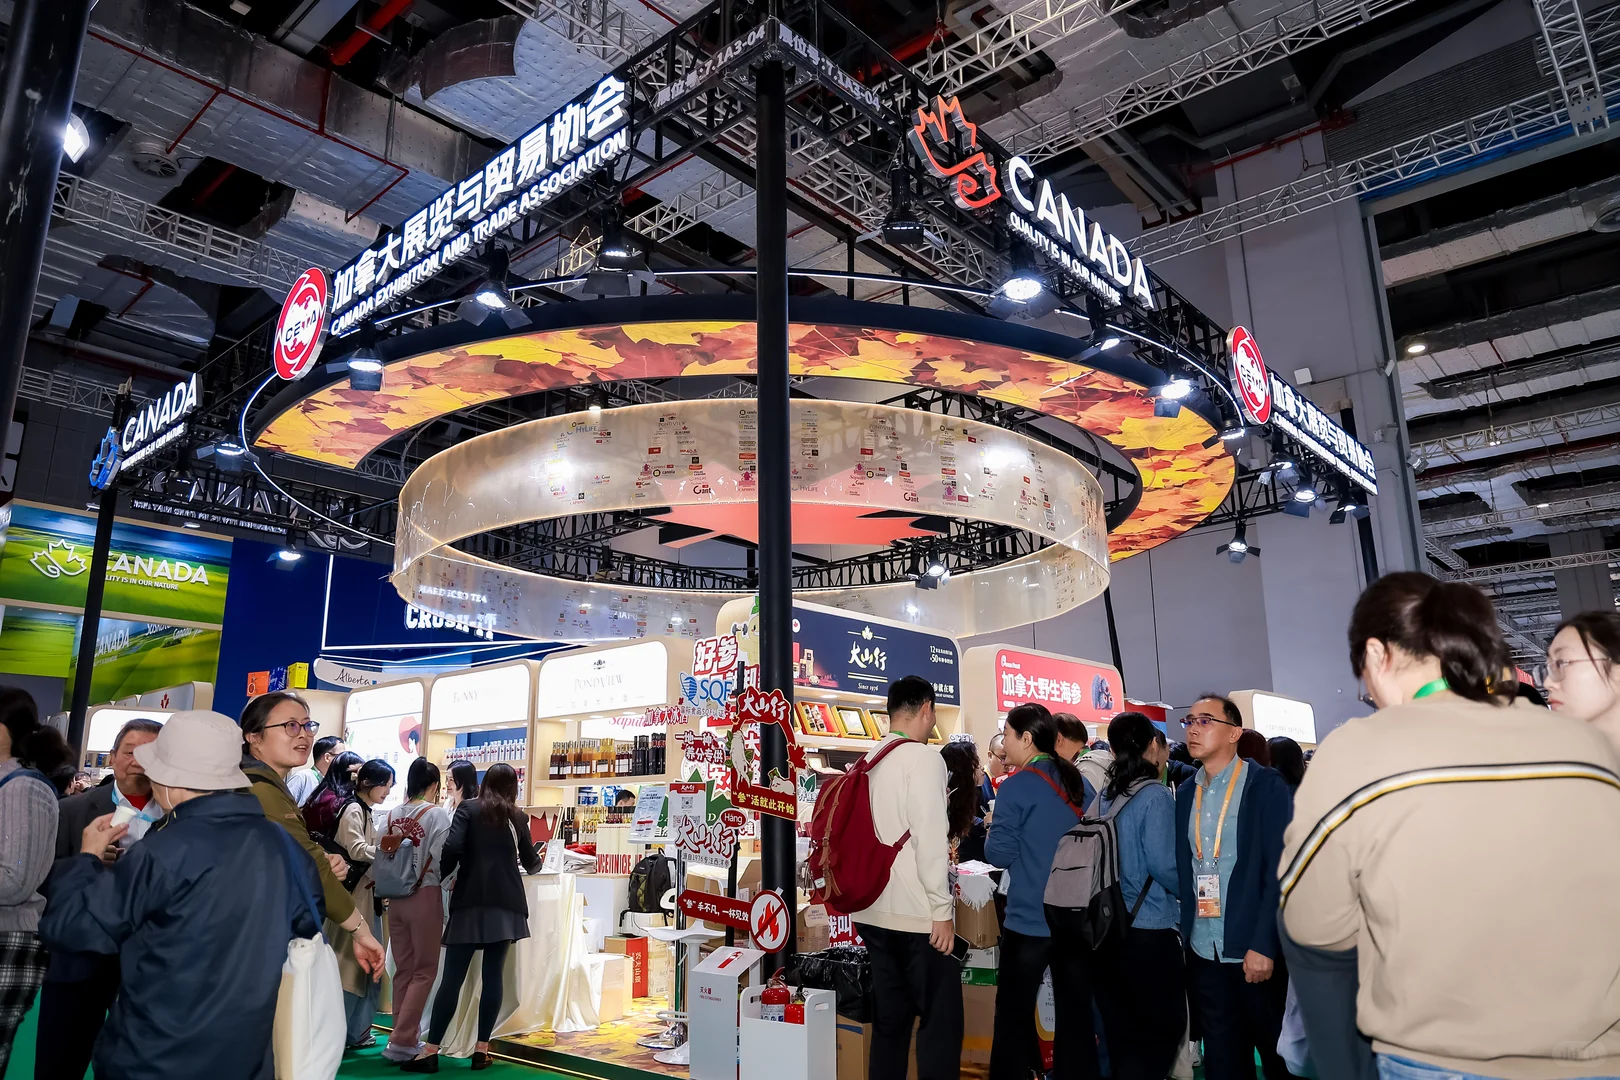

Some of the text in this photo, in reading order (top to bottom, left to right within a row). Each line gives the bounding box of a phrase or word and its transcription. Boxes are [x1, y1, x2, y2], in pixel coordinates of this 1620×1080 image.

[332, 74, 625, 314] 加拿大展览与贸易协会
[330, 128, 629, 336] CANADA EXHIBITION AND TRADE ASSOCIATION
[1008, 156, 1154, 308] CANADA
[1010, 211, 1122, 306] QUALITY IS IN OUR NATURE
[122, 373, 197, 452] CANADA
[107, 551, 209, 586] ANADA
[154, 582, 178, 591] NATURE
[848, 640, 888, 672] 大山行
[334, 668, 371, 686] Alberta
[699, 679, 733, 706] SQF
[1001, 670, 1082, 705] 加拿大野生海参
[742, 693, 786, 724] 大山行
[675, 814, 736, 858] 大山行
